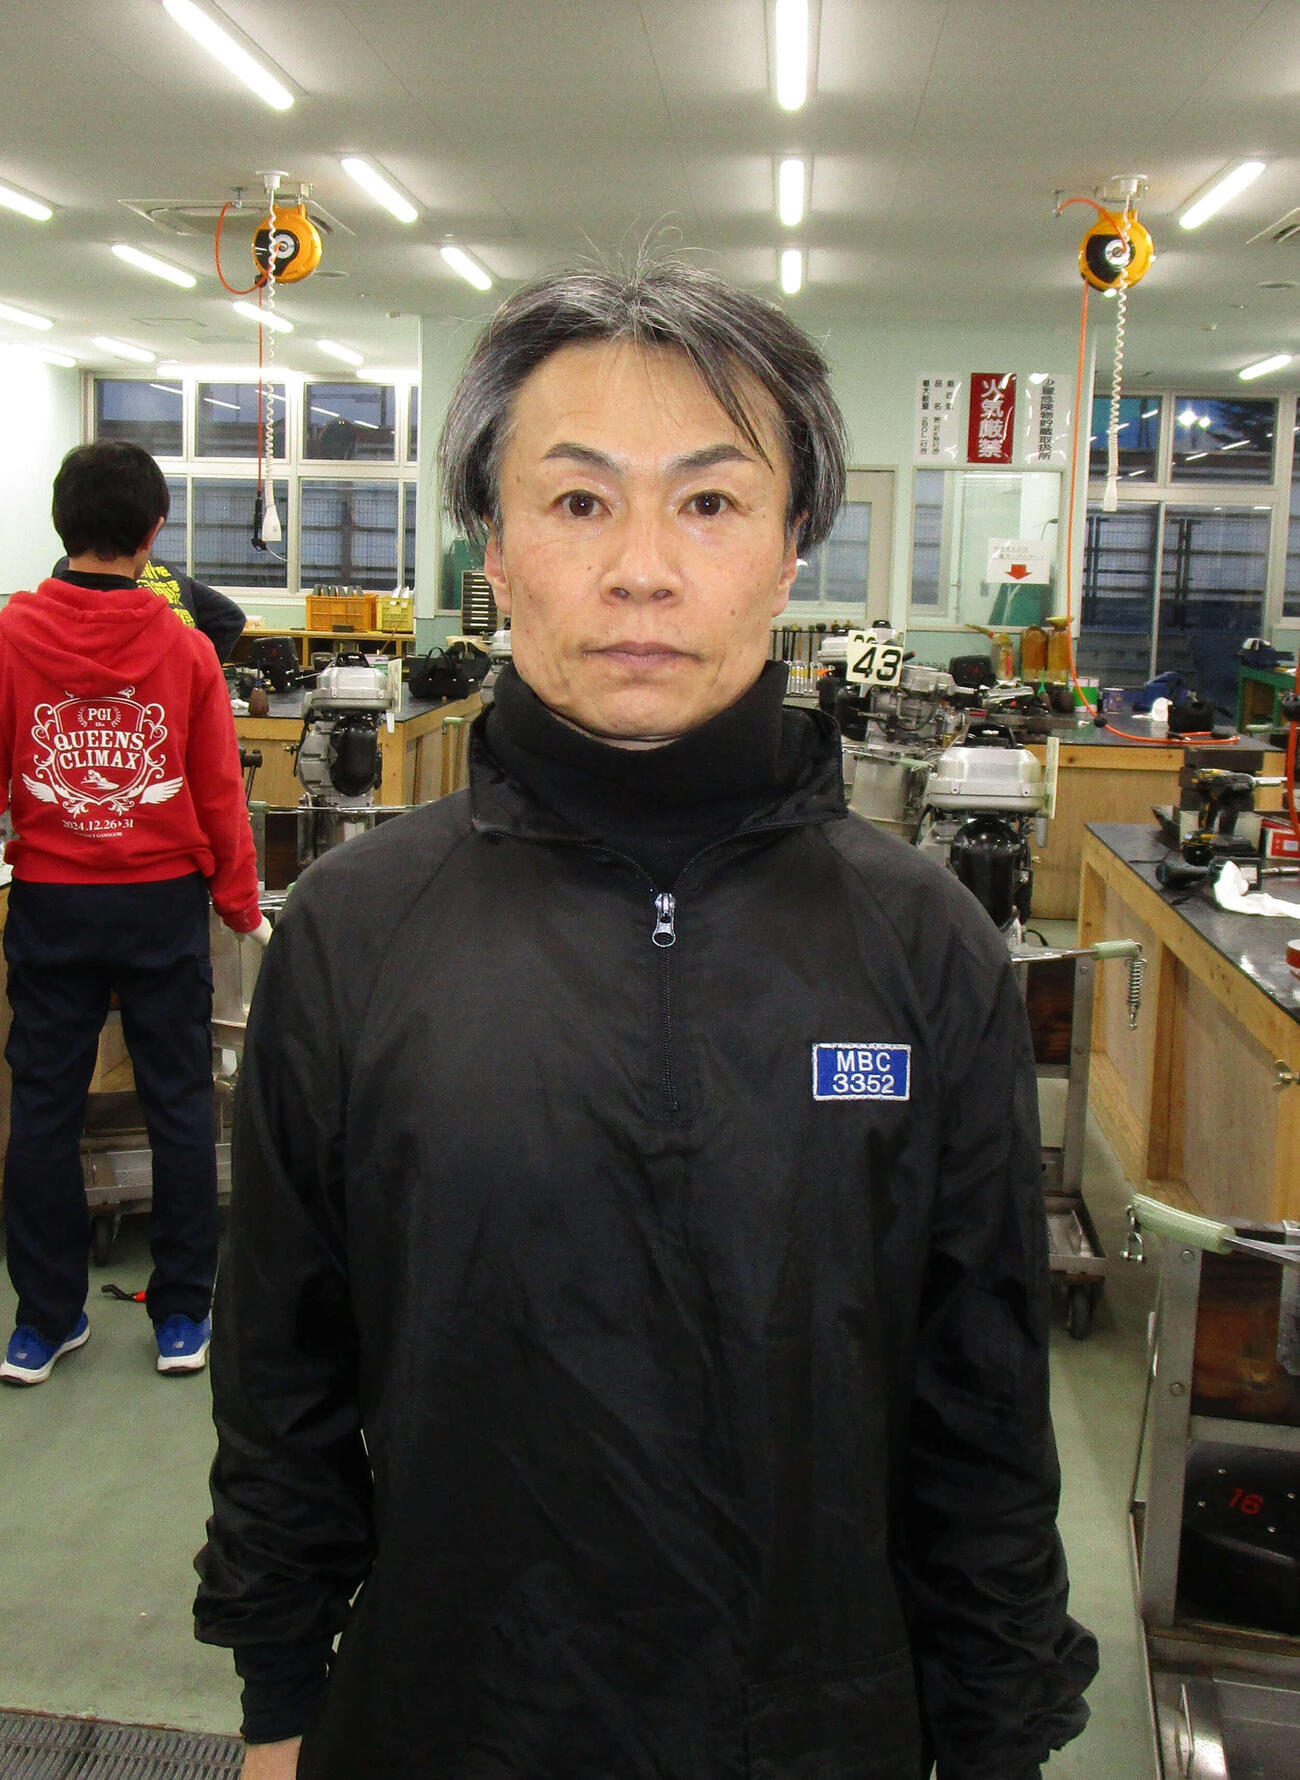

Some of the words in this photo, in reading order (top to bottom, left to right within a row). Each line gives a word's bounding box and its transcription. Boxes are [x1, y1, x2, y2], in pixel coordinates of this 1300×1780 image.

[978, 379, 1005, 459] 火気厳禁
[852, 647, 902, 681] 43
[53, 730, 145, 751] QUEENS
[59, 750, 141, 770] CLIMAX
[836, 1051, 891, 1072] MBC
[832, 1073, 895, 1094] 3352
[1229, 1488, 1264, 1514] 16
